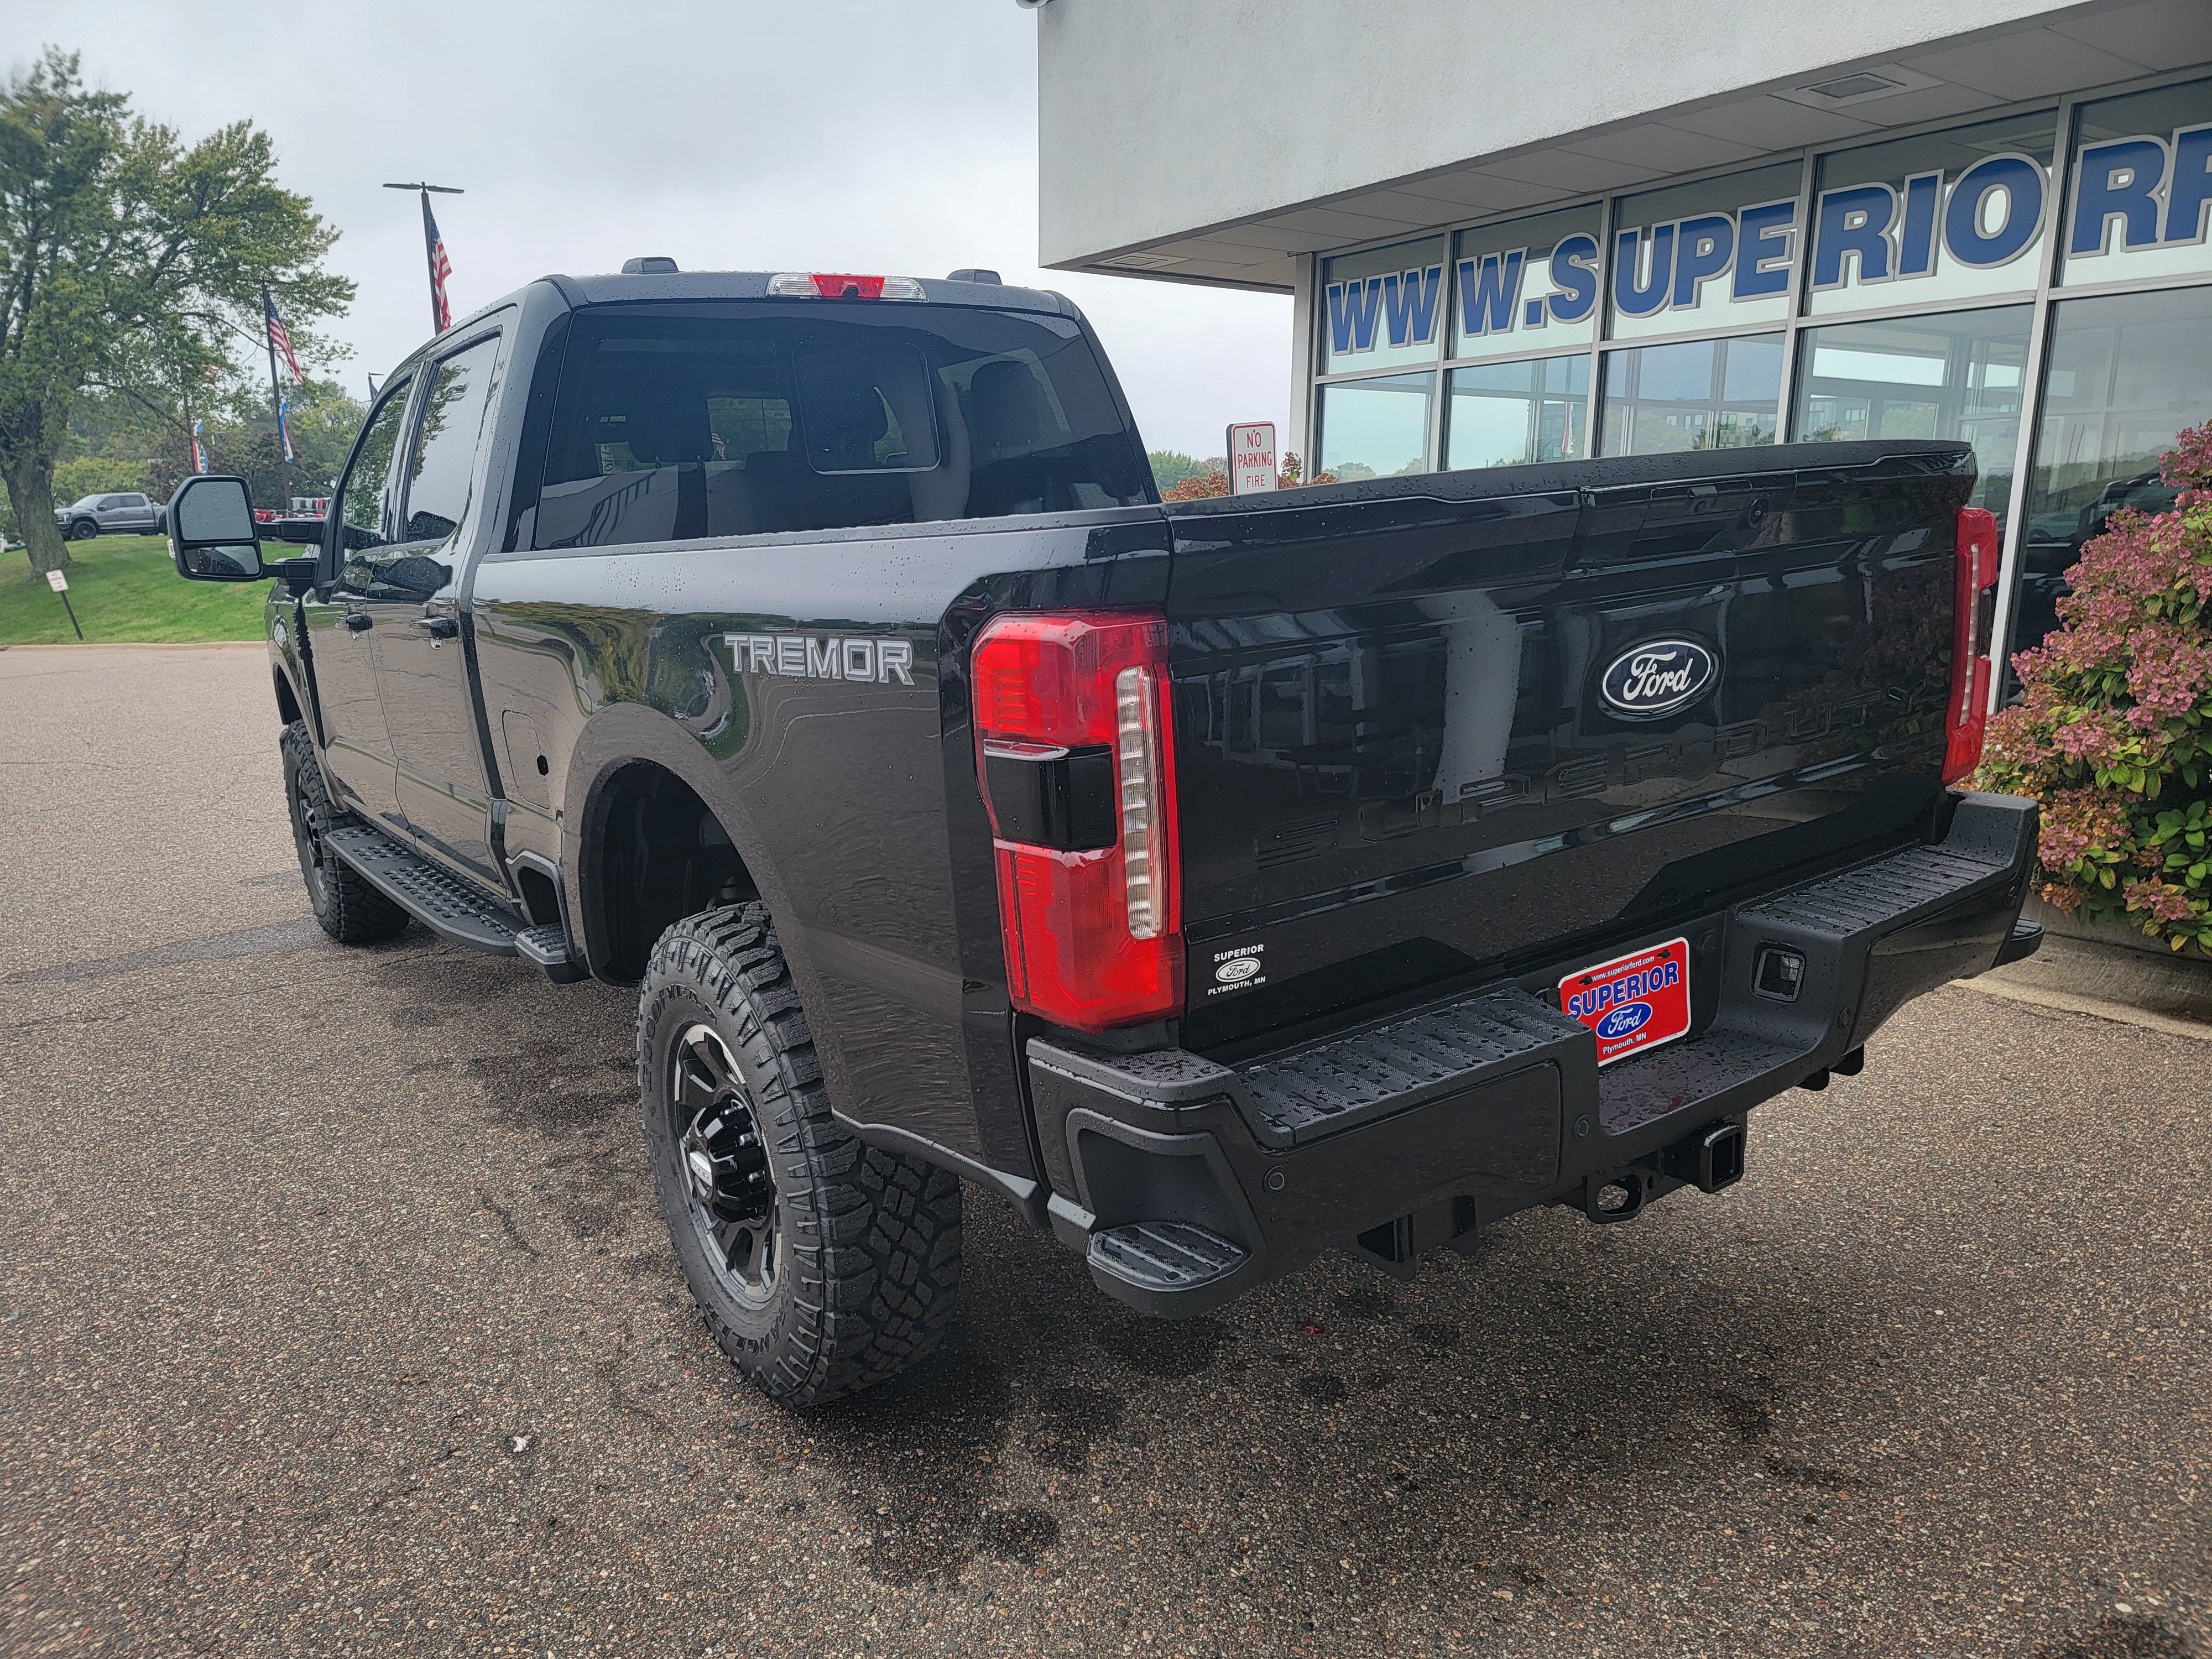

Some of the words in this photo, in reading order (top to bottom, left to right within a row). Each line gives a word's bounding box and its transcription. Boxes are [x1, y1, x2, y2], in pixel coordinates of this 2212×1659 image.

[1246, 432, 1262, 448] NO
[1238, 451, 1272, 469] PARKING
[1246, 474, 1266, 488] FIRE
[723, 633, 916, 686] TREMOR
[1623, 651, 1694, 701] Ford
[1213, 943, 1264, 962] SUPERIOR
[1226, 963, 1251, 977] Ford
[1592, 956, 1655, 982] www.superiorford.com
[1208, 979, 1252, 996] PLYMOUTH,
[1254, 975, 1266, 985] MN
[1568, 961, 1679, 1020] SUPERIOR
[1608, 1008, 1642, 1035] Ford
[1603, 1036, 1635, 1055] Plymouth,
[1636, 1032, 1647, 1041] MN
